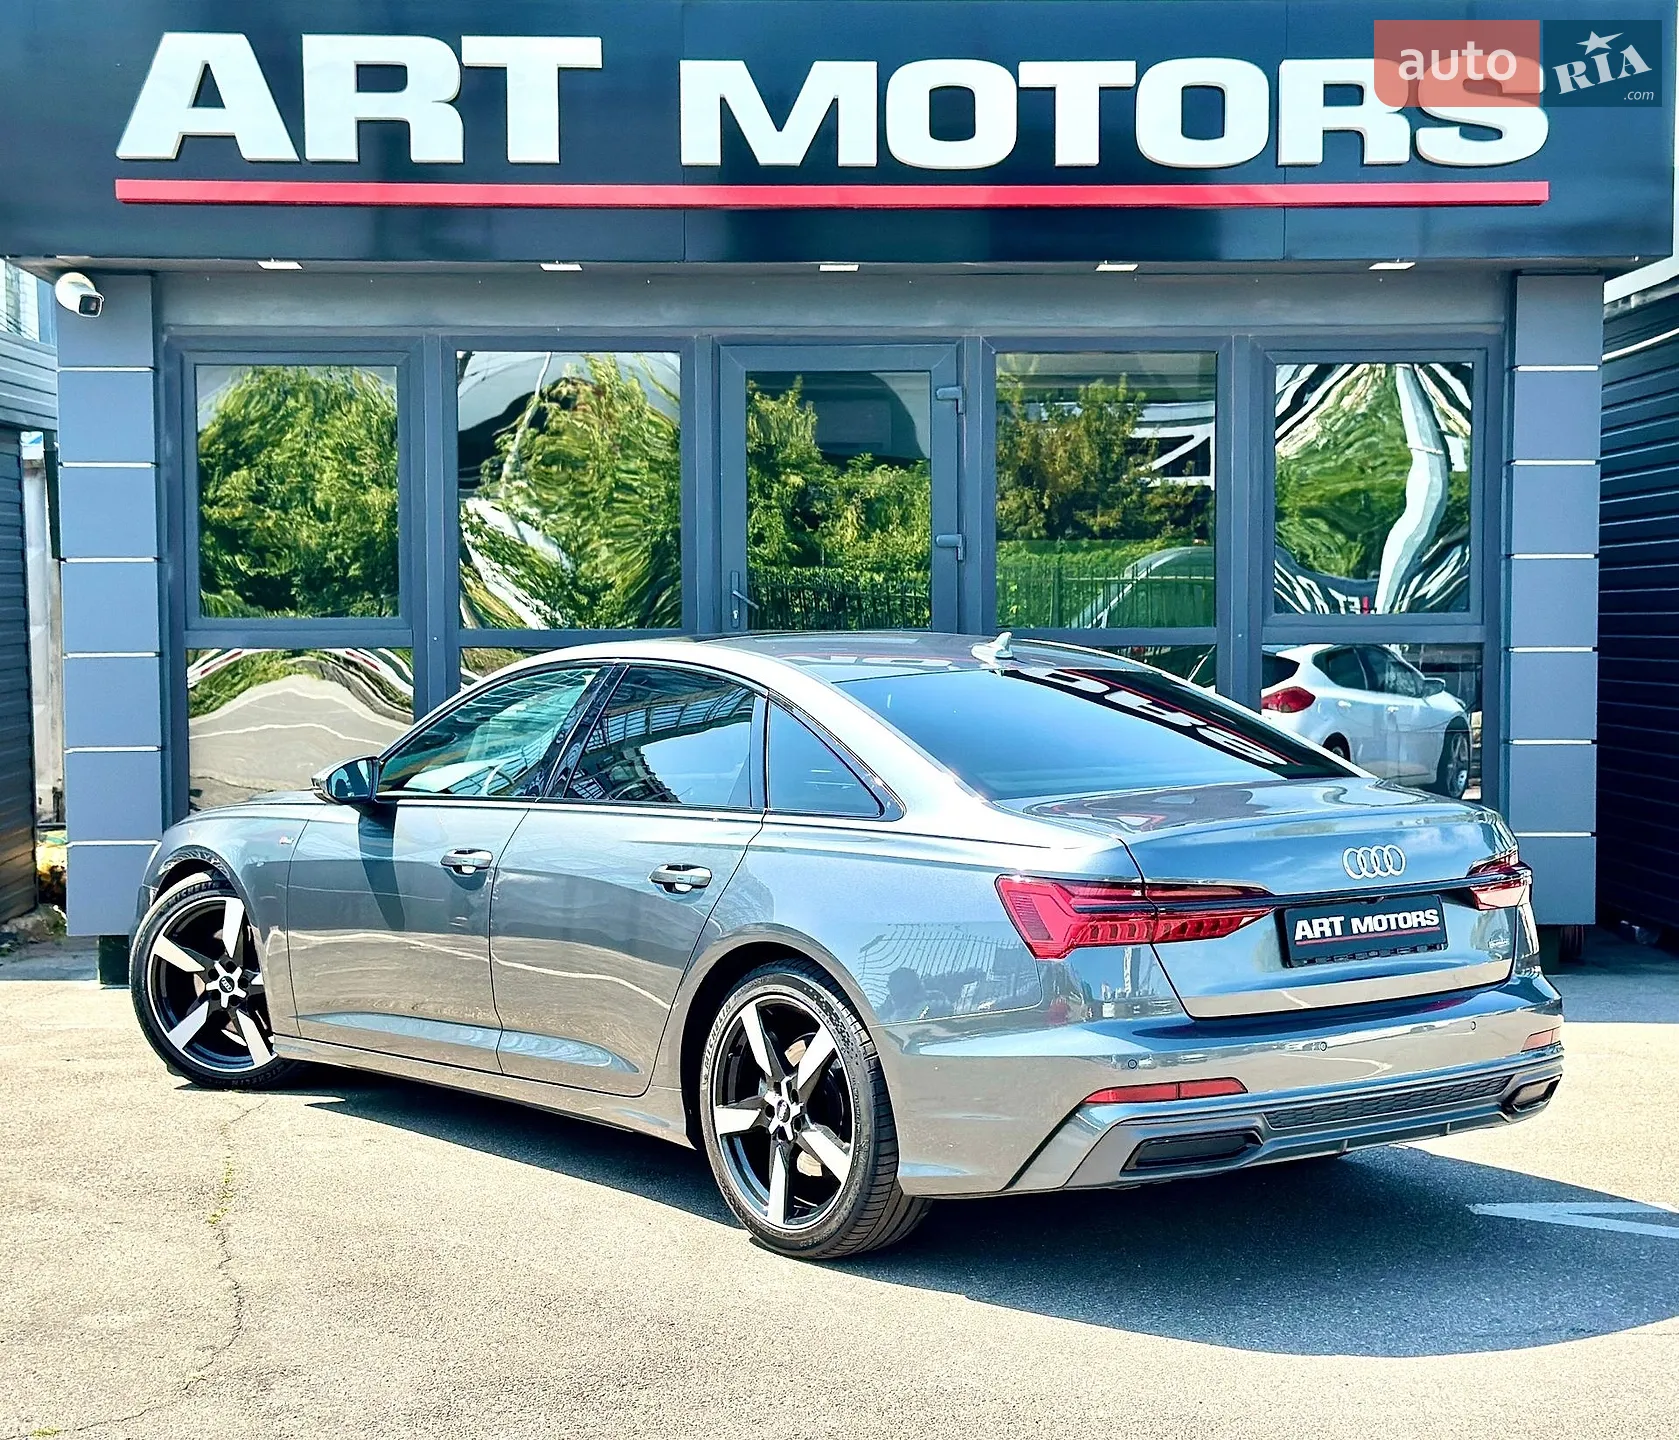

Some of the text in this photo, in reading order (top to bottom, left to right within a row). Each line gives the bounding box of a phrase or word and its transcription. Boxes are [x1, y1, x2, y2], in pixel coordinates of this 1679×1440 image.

[115, 31, 1549, 169] ART MOTORS
[1294, 908, 1441, 941] ART MOTORS
